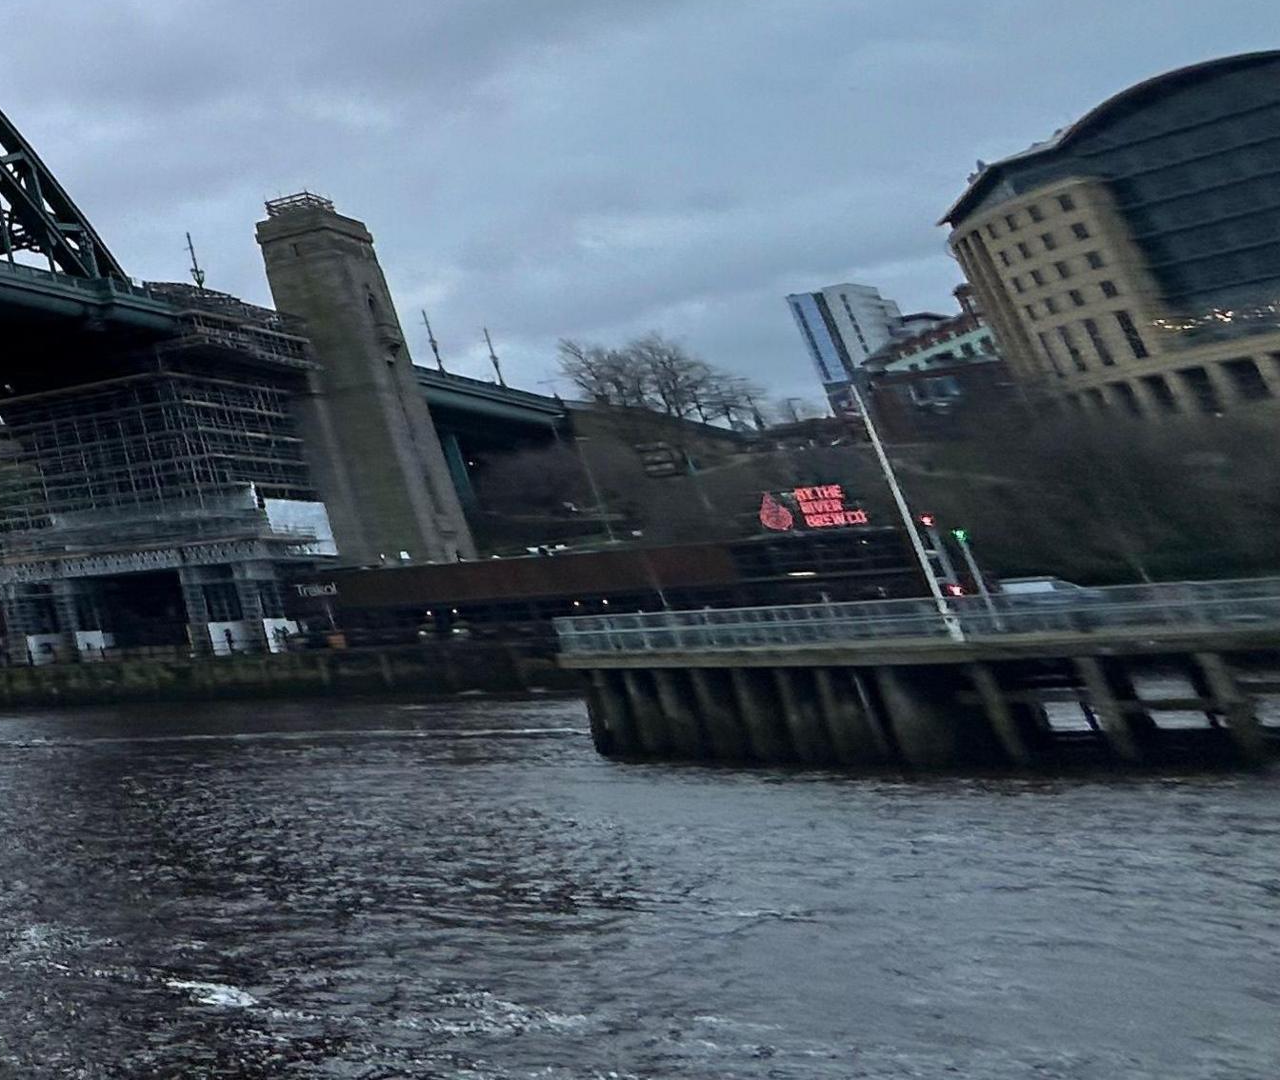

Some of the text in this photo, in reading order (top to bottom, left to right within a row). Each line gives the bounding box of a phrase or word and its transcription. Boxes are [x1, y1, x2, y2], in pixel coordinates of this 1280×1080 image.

[814, 484, 843, 499] THE
[799, 499, 843, 513] RIVER
[805, 511, 845, 527] BREW
